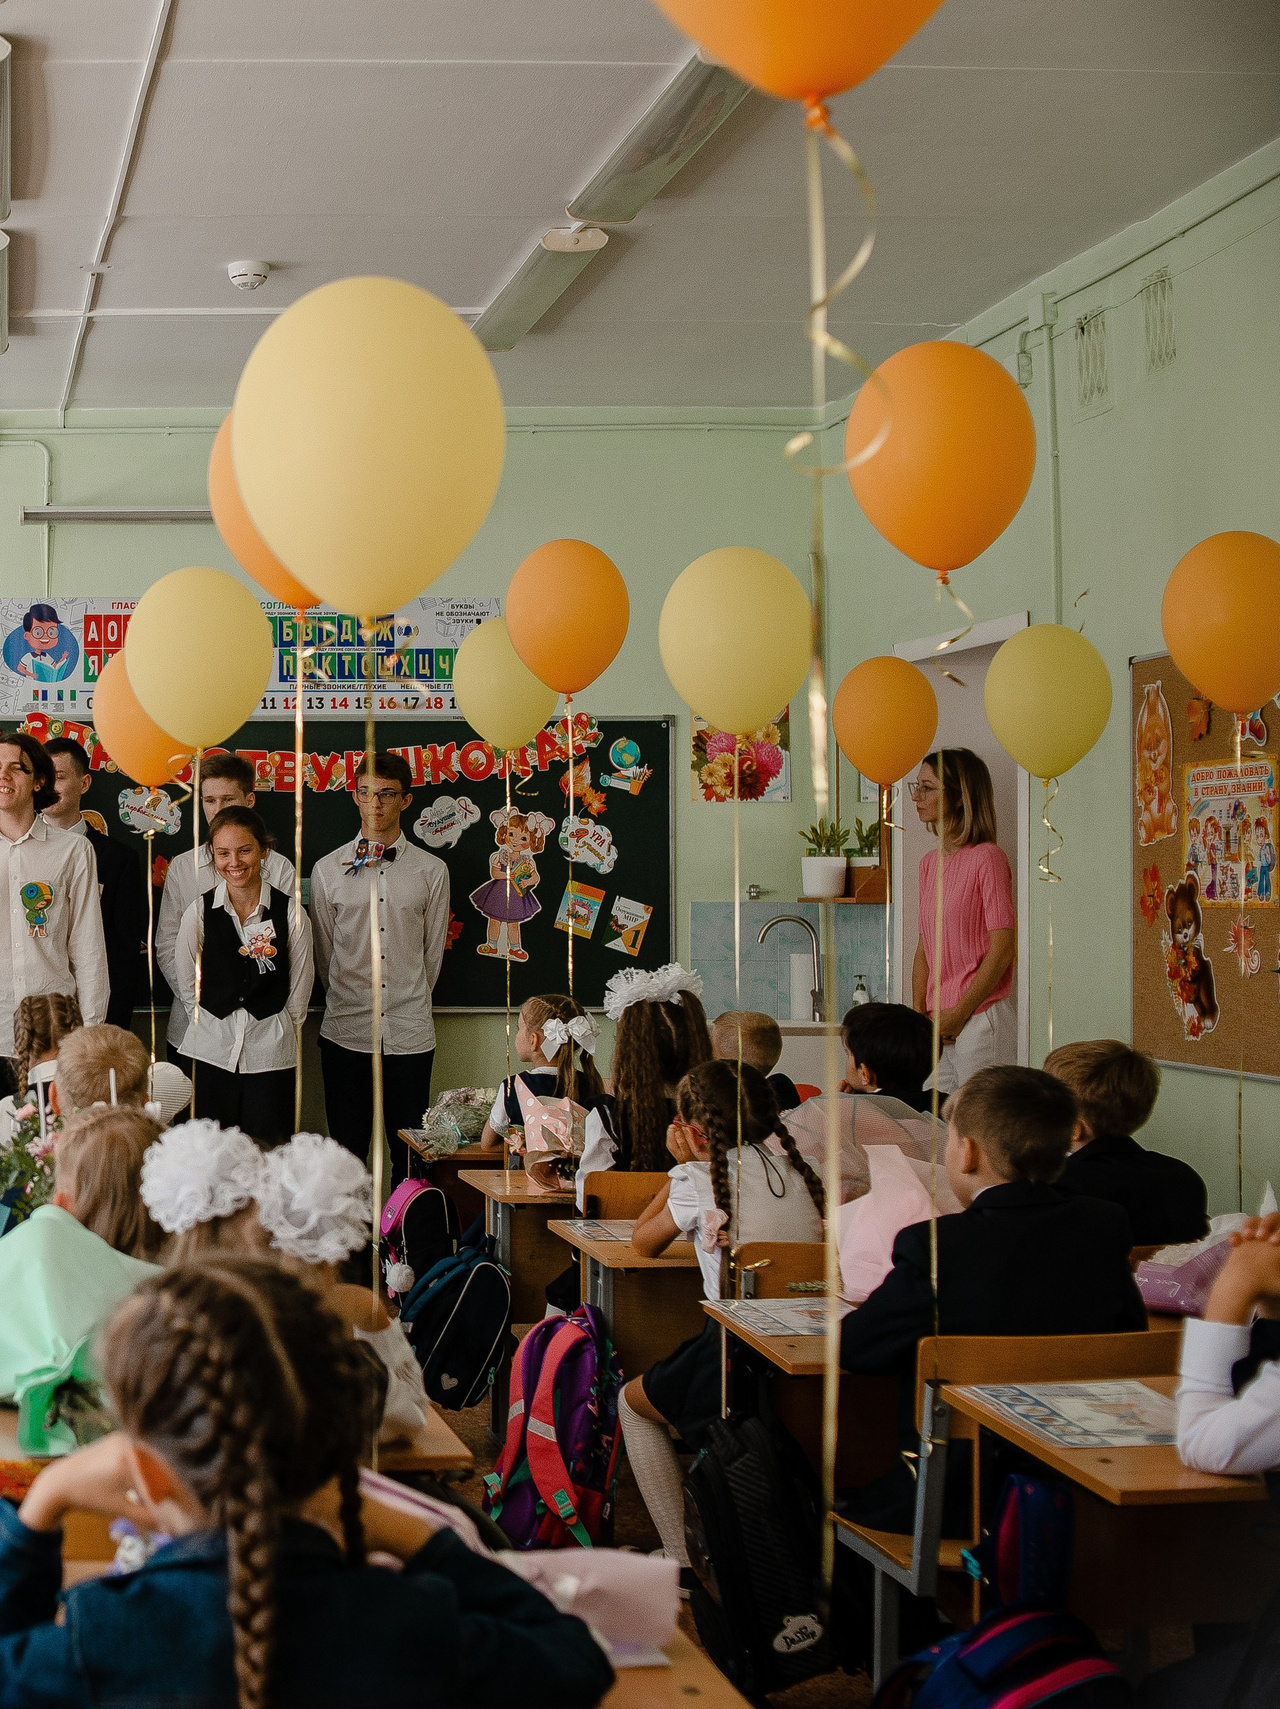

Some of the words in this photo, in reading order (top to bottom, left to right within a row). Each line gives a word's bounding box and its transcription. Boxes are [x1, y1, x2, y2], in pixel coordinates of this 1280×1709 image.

[111, 602, 138, 610] ГЛАС
[88, 621, 99, 642] А
[107, 621, 118, 642] О
[283, 620, 293, 641] Б
[340, 619, 352, 642] Д
[377, 621, 393, 641] Ж
[88, 655, 98, 676] Я
[283, 655, 293, 676] П
[322, 656, 332, 676] К
[342, 655, 351, 675] Т
[400, 655, 410, 675] Х
[419, 654, 430, 677] Ц
[439, 655, 450, 675] Ч
[261, 697, 277, 710] 11
[306, 697, 325, 710] 13
[330, 697, 349, 710] 14
[355, 697, 373, 710] 15
[378, 697, 398, 710] 16
[403, 697, 420, 710] 17
[425, 696, 444, 710] 18
[1191, 770, 1214, 782] ДОБРО
[1216, 766, 1270, 780] ПОЖАЛОВАТЬ
[1194, 788, 1199, 797] В
[1201, 785, 1229, 797] СТРАНУ
[569, 827, 589, 843] Я
[589, 830, 606, 848] УРА
[628, 929, 641, 949] 1
